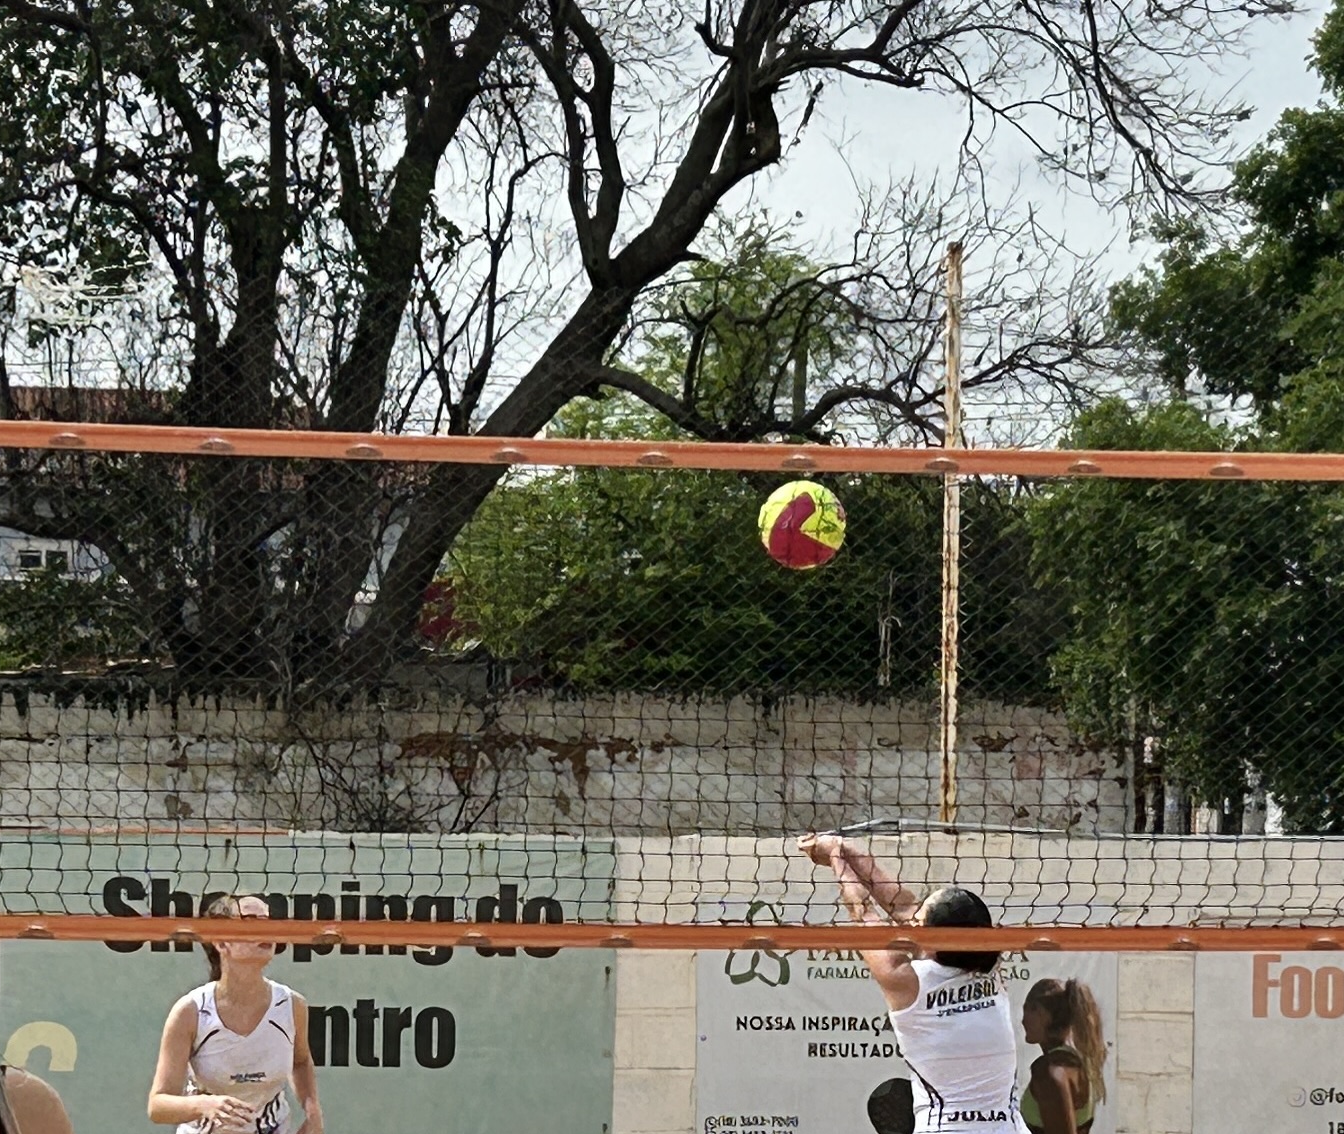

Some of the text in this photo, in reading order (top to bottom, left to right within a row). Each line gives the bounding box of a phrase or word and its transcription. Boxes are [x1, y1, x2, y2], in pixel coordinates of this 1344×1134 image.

[308, 998, 456, 1068] ntro
[736, 1011, 895, 1036] NOSSA INSPIRAÇÃ
